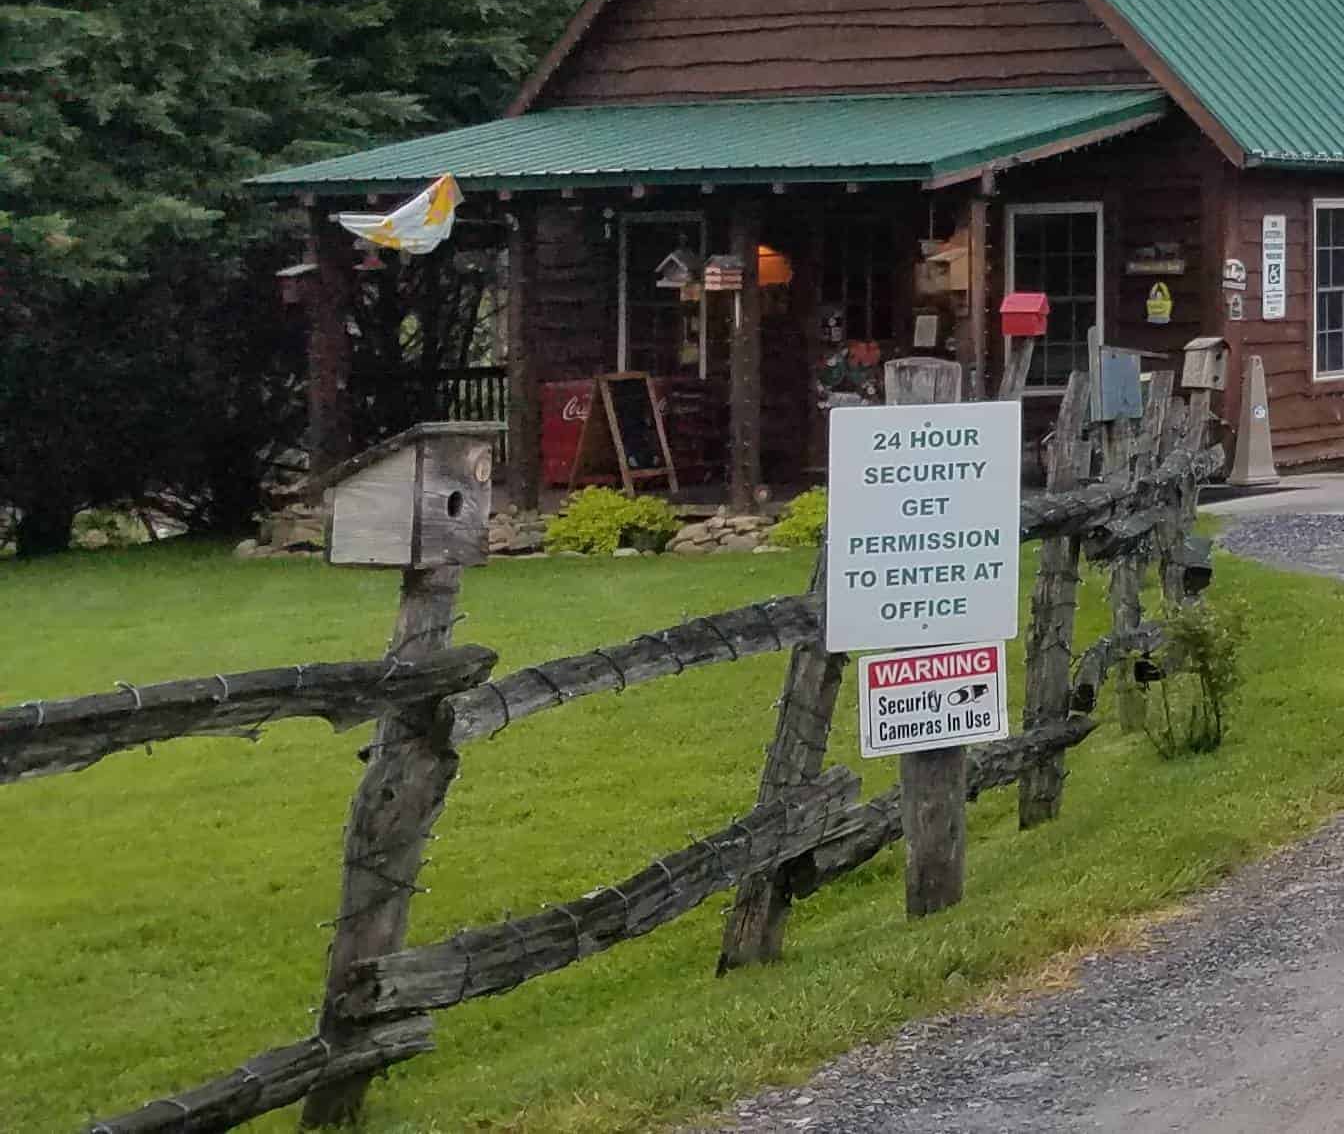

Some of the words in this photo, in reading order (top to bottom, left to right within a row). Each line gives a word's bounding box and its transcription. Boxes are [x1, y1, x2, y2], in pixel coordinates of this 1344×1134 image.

[873, 432, 901, 451] 24
[910, 429, 979, 449] HOUR
[863, 462, 987, 484] SECURITY
[901, 497, 950, 517] GET
[849, 528, 1000, 555] PERMISSION
[845, 569, 877, 589] TO
[886, 564, 965, 587] ENTER
[973, 562, 1003, 581] AT
[880, 597, 967, 620] OFFICE
[875, 652, 991, 685] WARNING
[878, 689, 942, 716] Security
[879, 712, 942, 741] Cameras
[947, 712, 961, 732] In
[965, 707, 991, 729] Use
